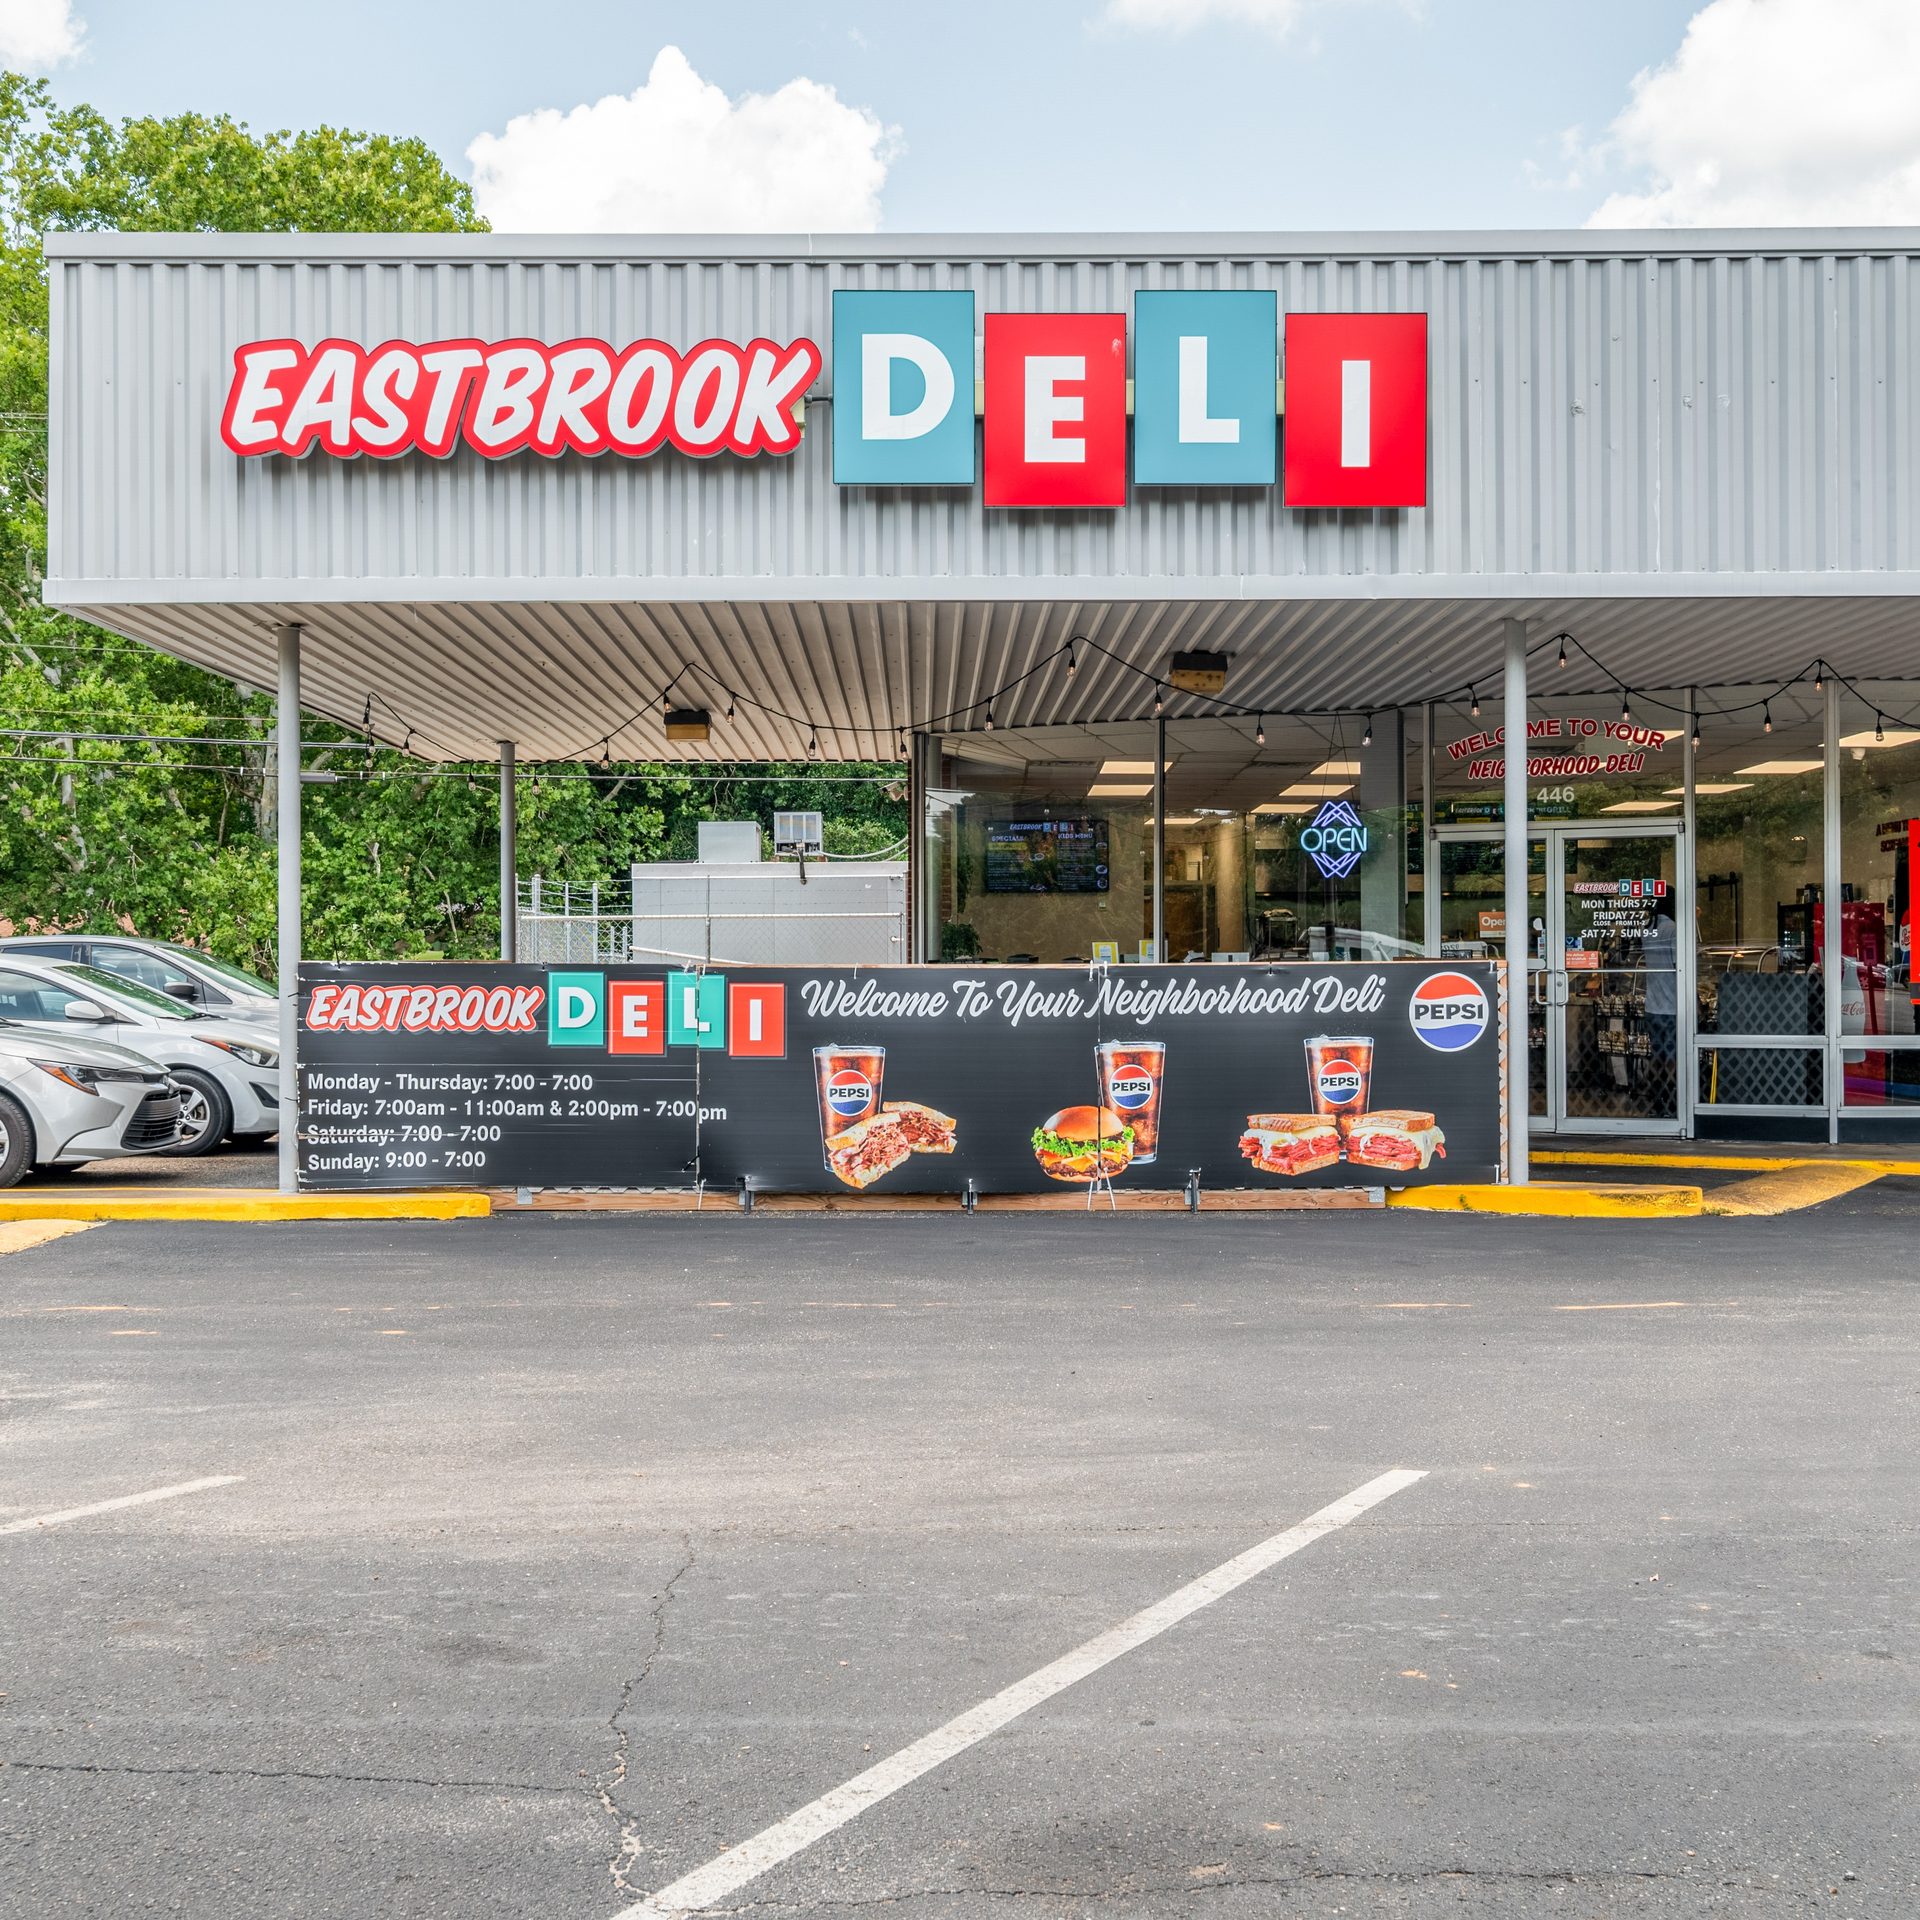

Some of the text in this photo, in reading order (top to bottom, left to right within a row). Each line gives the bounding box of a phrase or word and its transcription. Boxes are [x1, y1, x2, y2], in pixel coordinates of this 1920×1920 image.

[226, 333, 1371, 468] EASTBROOK DELI
[1446, 718, 1666, 760] WELCME TO YOUR
[1468, 752, 1646, 779] NEIGORHOOD DELI
[1536, 786, 1575, 803] 446
[1300, 827, 1367, 852] OPEN
[1574, 882, 1663, 895] EASTBROOK DELI
[1581, 899, 1658, 909] MON THURS 7-7
[1593, 911, 1646, 920] FRIDAY 7-7
[1581, 929, 1659, 938] SAT 7-7 SUN 9-5
[800, 974, 1387, 1027] Welcome To Your Neighborhood Deli
[1414, 1003, 1484, 1020] PEPSI
[307, 986, 763, 1042] EASTBROOK DELI
[308, 1073, 381, 1094] Monday
[395, 1073, 488, 1095] Thursday:
[494, 1074, 535, 1091] 7:00
[552, 1074, 593, 1091] 7:00
[829, 1087, 870, 1098] PEPSI
[1112, 1082, 1151, 1092] PEPSI
[1320, 1077, 1359, 1087] PEPSI
[308, 1099, 369, 1120] Friday:
[374, 1099, 445, 1116] 7:00am
[464, 1099, 544, 1116] 11:00am
[549, 1100, 563, 1116] &
[568, 1100, 639, 1120] 2:00pm
[655, 1100, 727, 1124] 7:00pm
[307, 1125, 395, 1147] Saturday:
[401, 1125, 442, 1142] 7:00
[460, 1125, 501, 1142] 7:00
[308, 1153, 380, 1174] Sunday:
[385, 1151, 428, 1168] 9:00
[444, 1151, 486, 1168] 7:00
